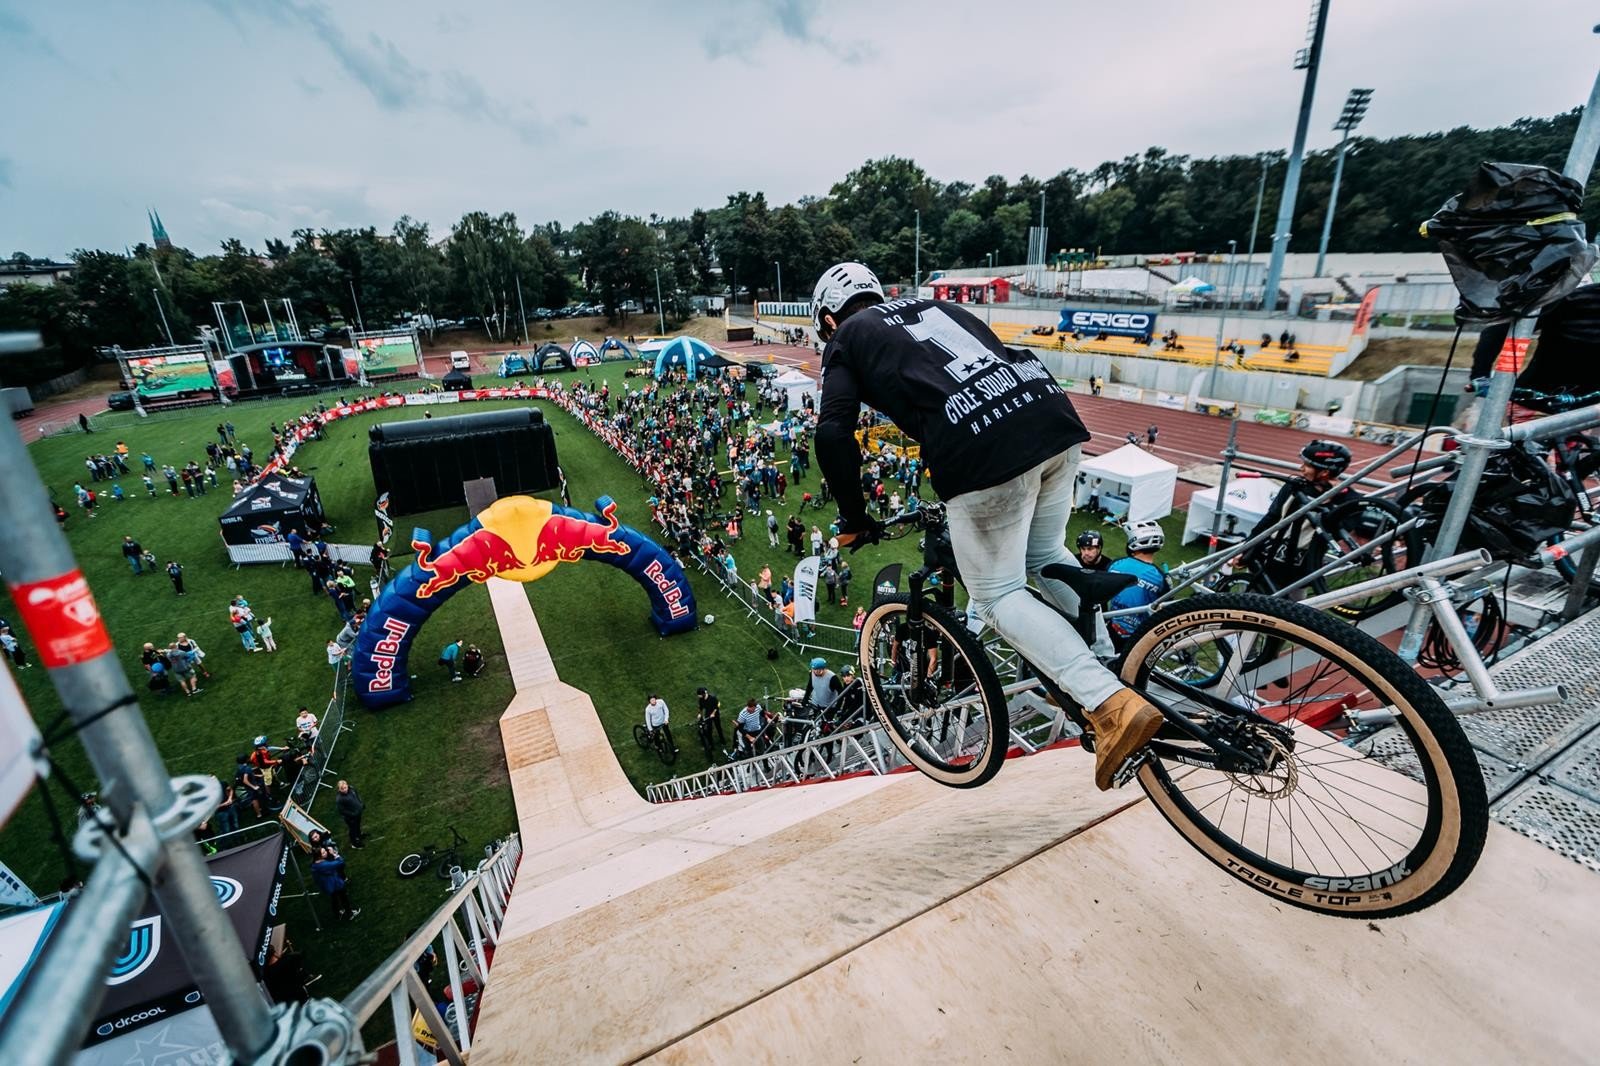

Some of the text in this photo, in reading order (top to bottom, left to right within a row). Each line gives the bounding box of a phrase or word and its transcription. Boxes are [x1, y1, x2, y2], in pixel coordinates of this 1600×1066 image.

[883, 306, 1009, 383] NO 1
[1072, 311, 1150, 329] ERIGO
[945, 387, 983, 424] CYCLE
[974, 366, 1018, 400] SQUAD
[643, 559, 689, 619] Red Bull
[1154, 612, 1277, 637] SCHWALBE
[369, 617, 411, 692] Red Bull
[1227, 858, 1361, 906] TABLE TOP
